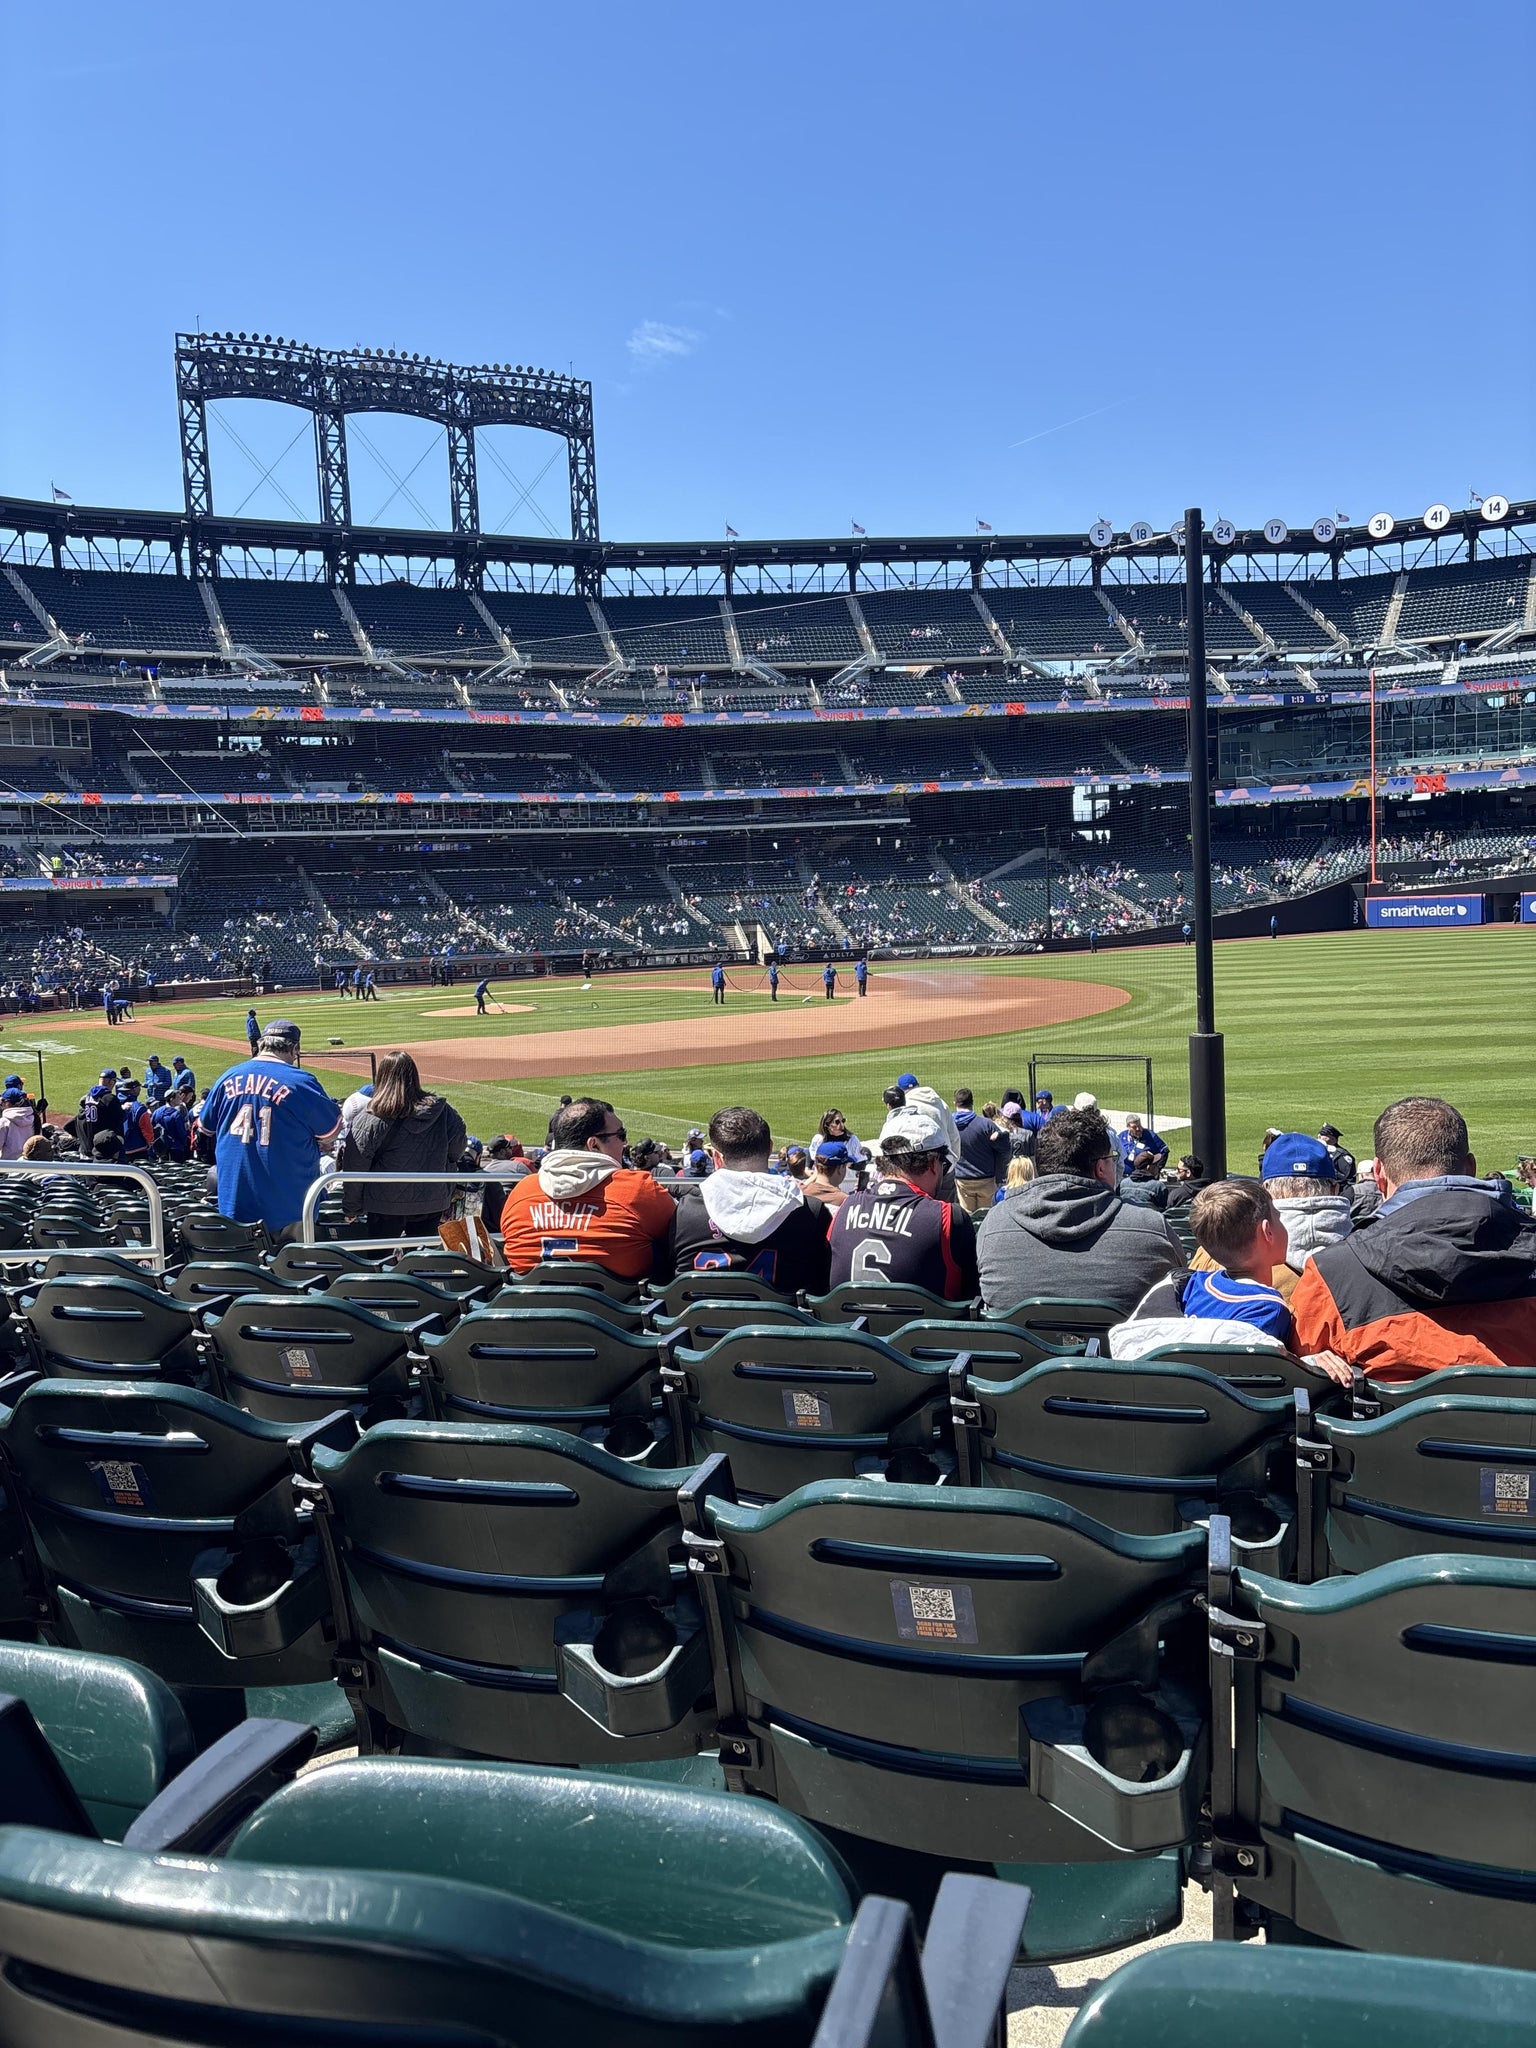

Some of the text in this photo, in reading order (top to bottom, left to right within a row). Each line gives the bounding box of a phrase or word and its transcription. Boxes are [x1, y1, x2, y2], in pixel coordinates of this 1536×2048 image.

[1488, 501, 1501, 514] 14
[1430, 510, 1443, 522] 41
[1318, 525, 1331, 536] 36
[1375, 519, 1387, 531] 31
[1097, 529, 1105, 541] 5
[1136, 529, 1147, 540] 18
[1217, 527, 1231, 538] 24
[1270, 526, 1281, 537] 17
[1291, 695, 1305, 704] 1:13
[1380, 904, 1455, 918] smartwater
[223, 1073, 291, 1106] SEAVER
[229, 1103, 272, 1146] 41
[529, 1201, 600, 1232] WRIGHT
[845, 1201, 914, 1238] McNEIL
[851, 1238, 892, 1282] 6
